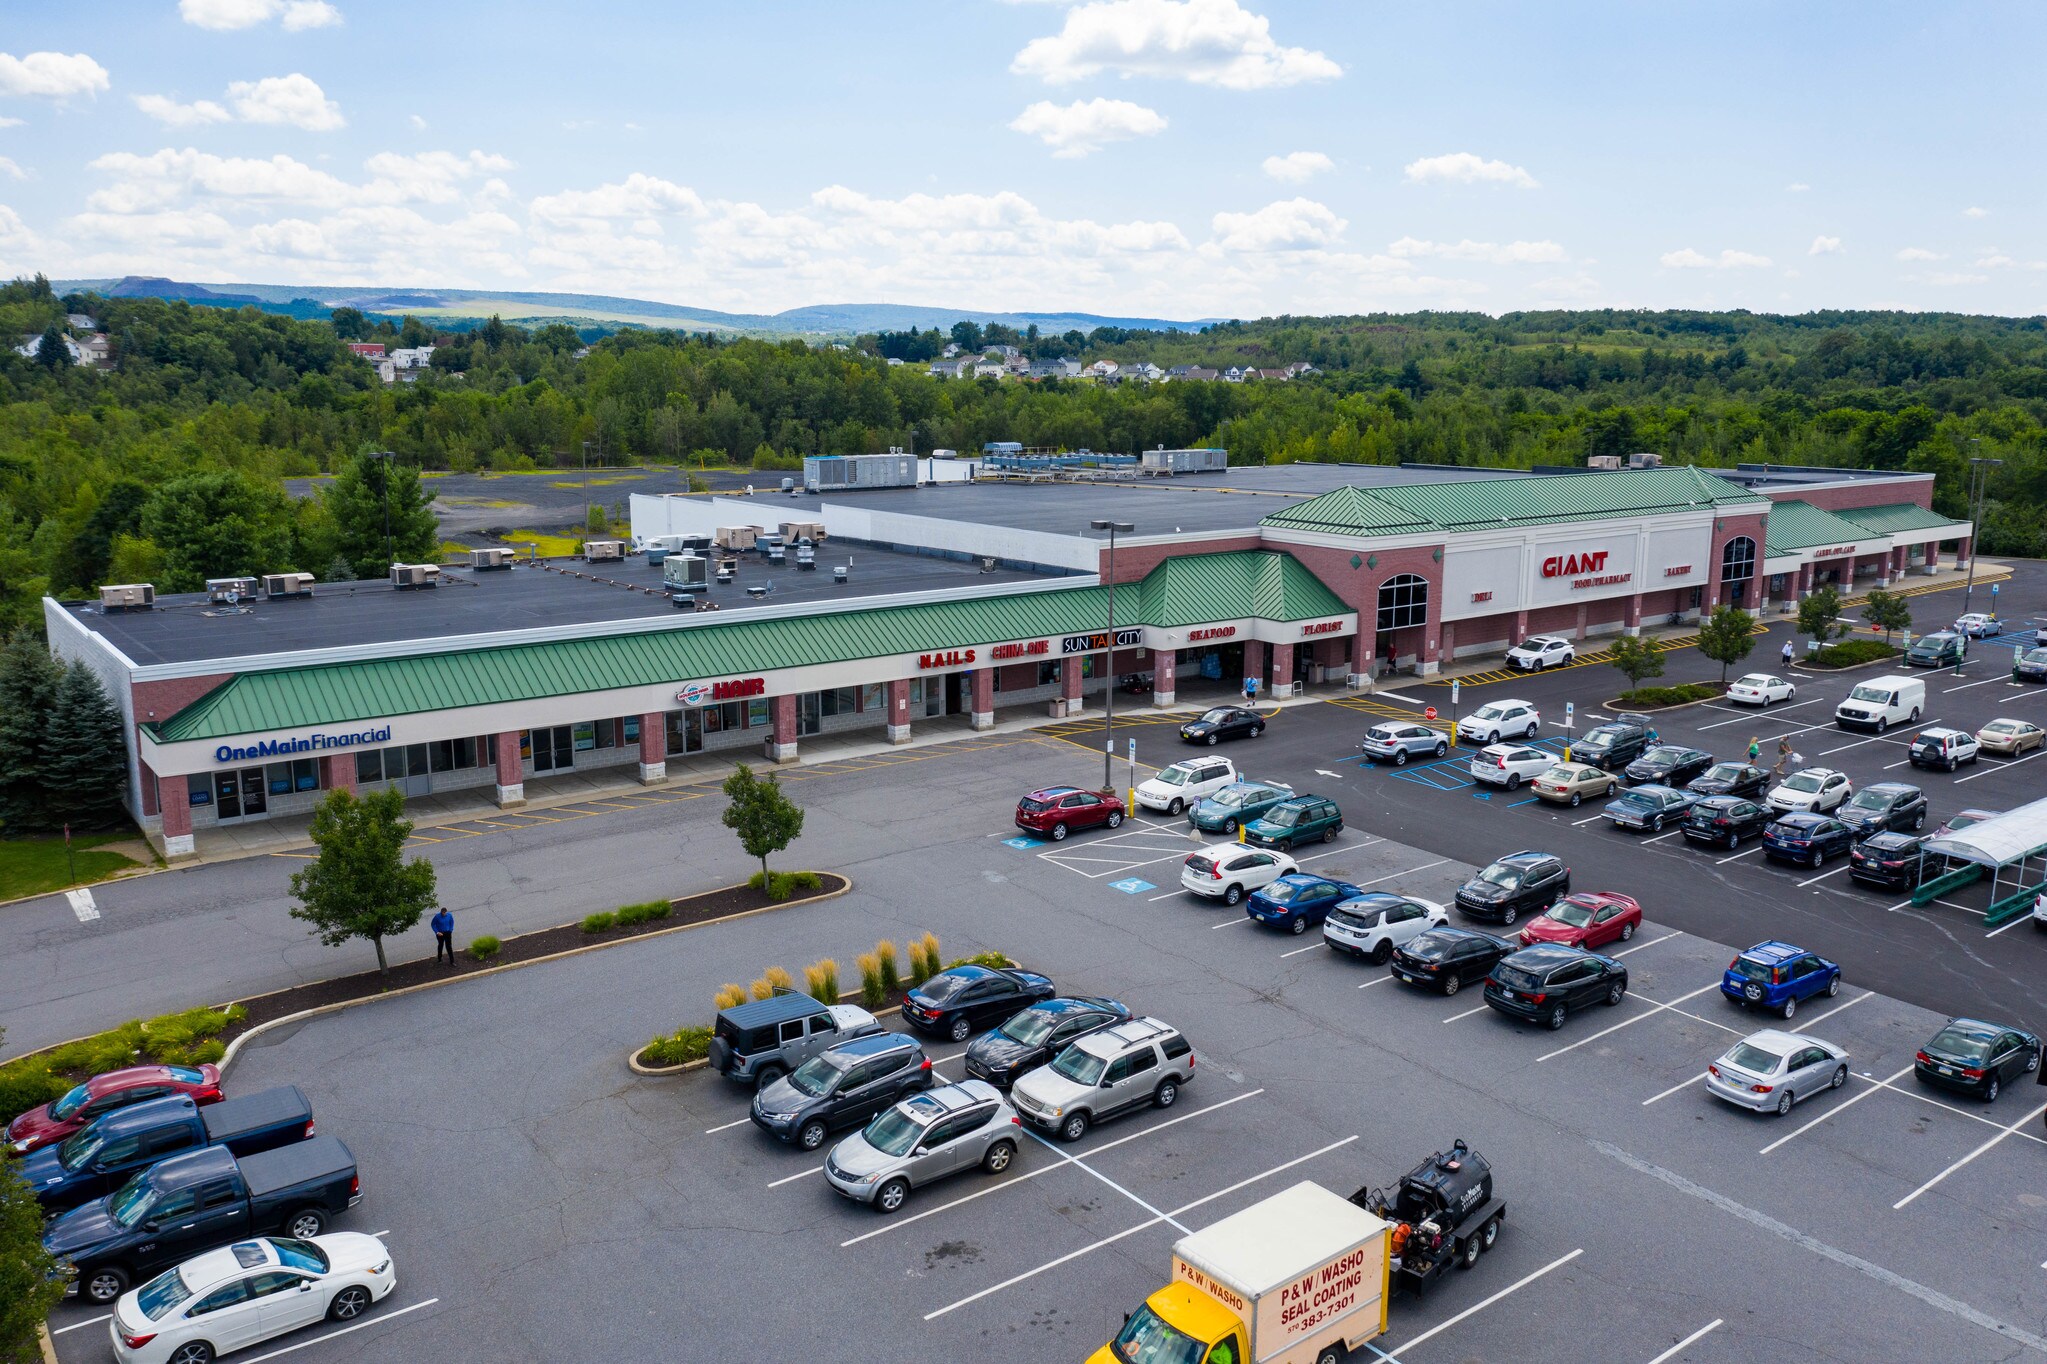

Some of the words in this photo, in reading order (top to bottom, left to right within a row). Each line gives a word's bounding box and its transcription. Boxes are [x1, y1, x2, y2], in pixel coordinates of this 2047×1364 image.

[1542, 551, 1608, 577] GIANT
[1474, 591, 1493, 602] DELI
[1189, 626, 1236, 641] SEAFOOD
[1303, 621, 1343, 636] FLORIST
[992, 643, 1025, 659] CHINA
[1027, 640, 1049, 655] ONE
[1065, 636, 1089, 652] SUN
[1090, 632, 1116, 649] TAN
[1117, 630, 1143, 645] CITY
[919, 649, 976, 670] NAILS
[713, 678, 765, 700] HAIR
[215, 725, 391, 762] OneMainFinancial
[1181, 1262, 1187, 1274] P
[1187, 1267, 1195, 1281] &
[1195, 1271, 1204, 1286] W
[1209, 1280, 1243, 1311] WASHO
[1281, 1289, 1289, 1307] P
[1291, 1284, 1301, 1301] &
[1302, 1275, 1314, 1295] W
[1321, 1249, 1364, 1284] WASHO
[1281, 1299, 1310, 1325] SEAL
[1313, 1270, 1362, 1307] COATING
[1287, 1322, 1300, 1334] 570
[1300, 1292, 1354, 1331] 383-7301
